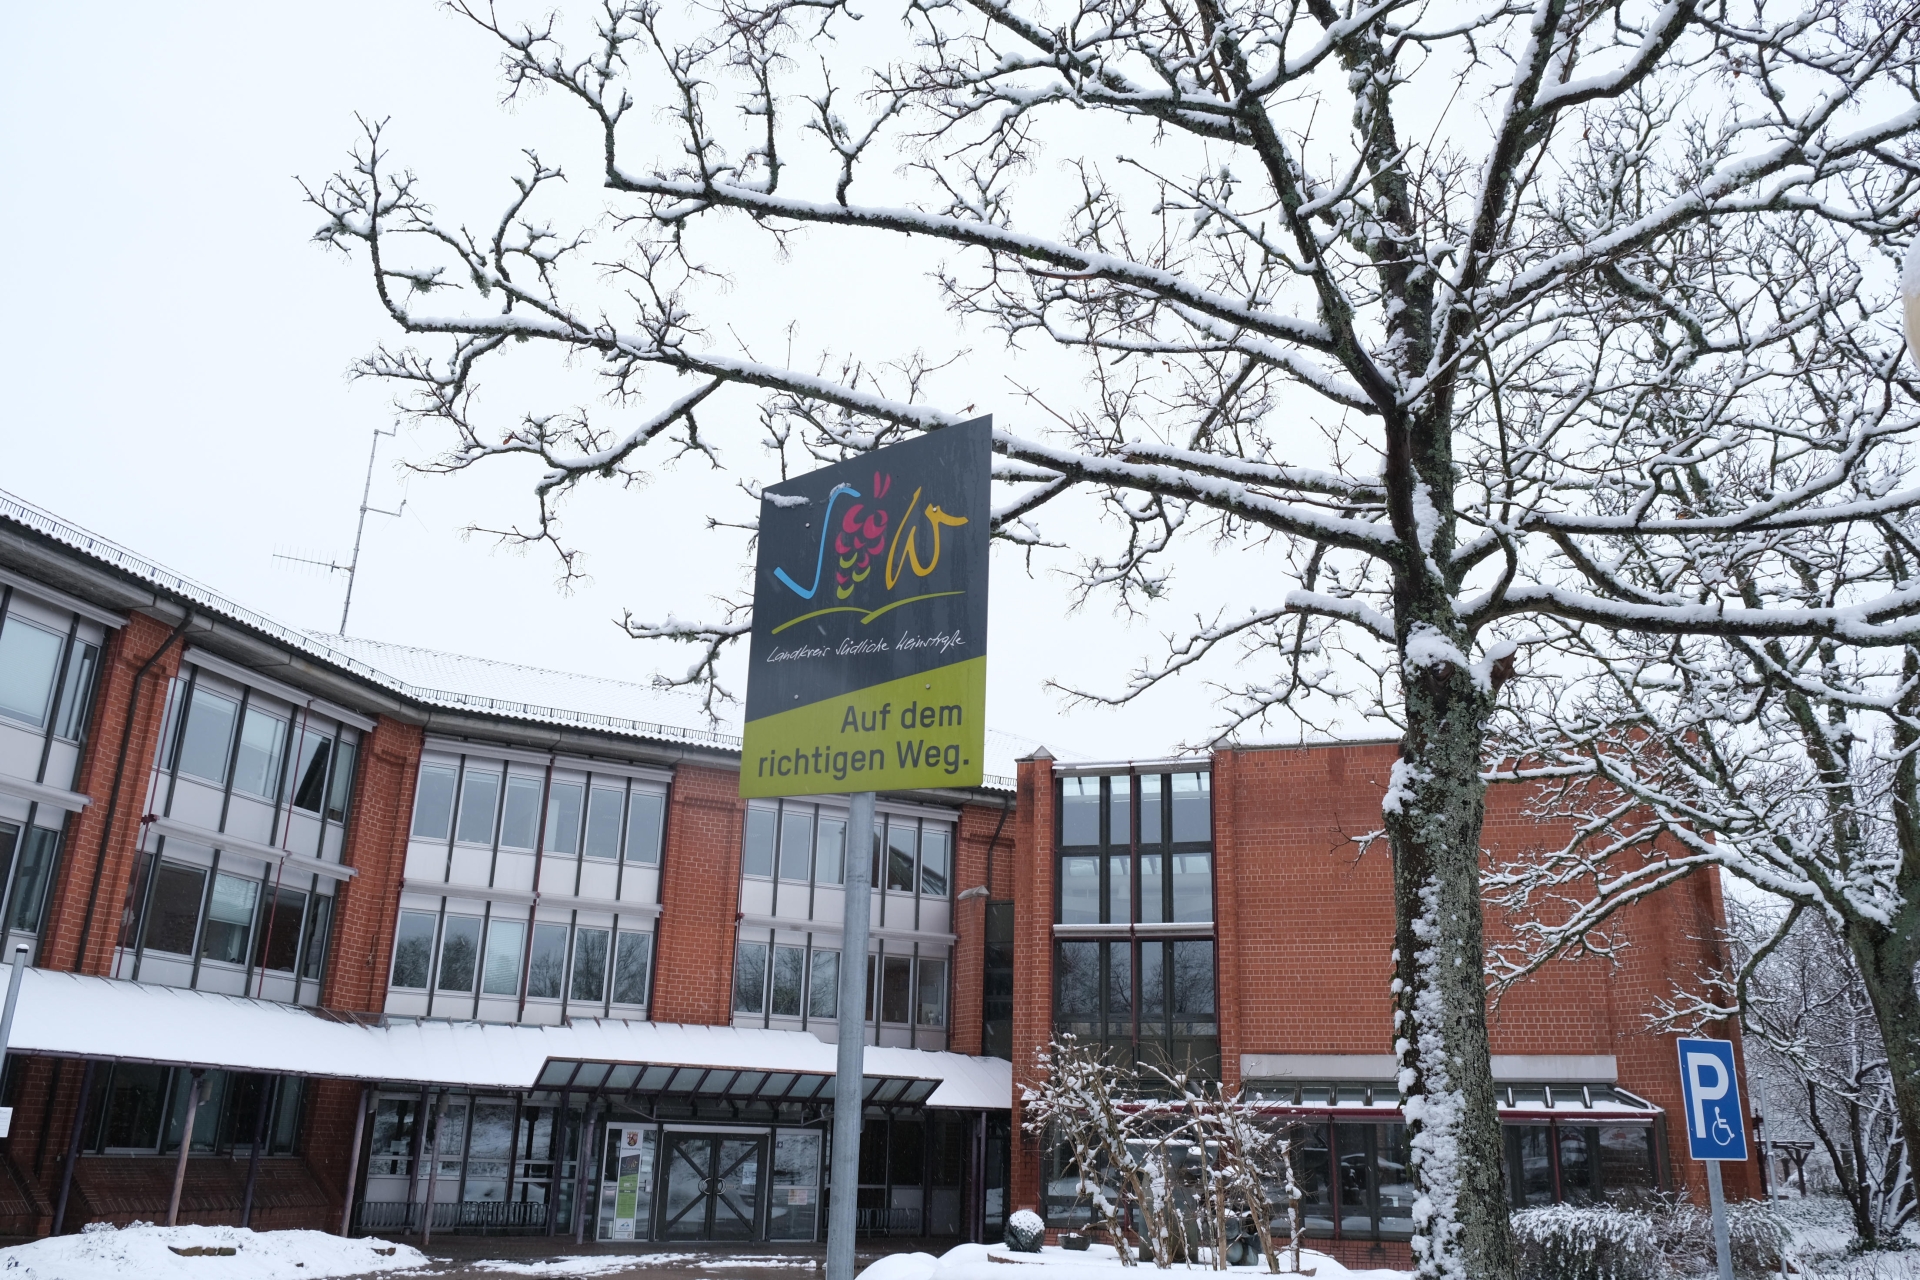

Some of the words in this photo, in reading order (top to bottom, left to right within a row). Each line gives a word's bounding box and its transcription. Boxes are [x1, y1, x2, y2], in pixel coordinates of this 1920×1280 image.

[766, 645, 830, 662] Landkreis
[836, 637, 889, 656] Südliche
[896, 630, 966, 653] Weinstraße
[840, 702, 891, 733] Auf
[900, 701, 963, 729] dem
[758, 745, 885, 781] richtigen
[896, 739, 970, 775] Weg.
[1686, 1052, 1729, 1138] P
